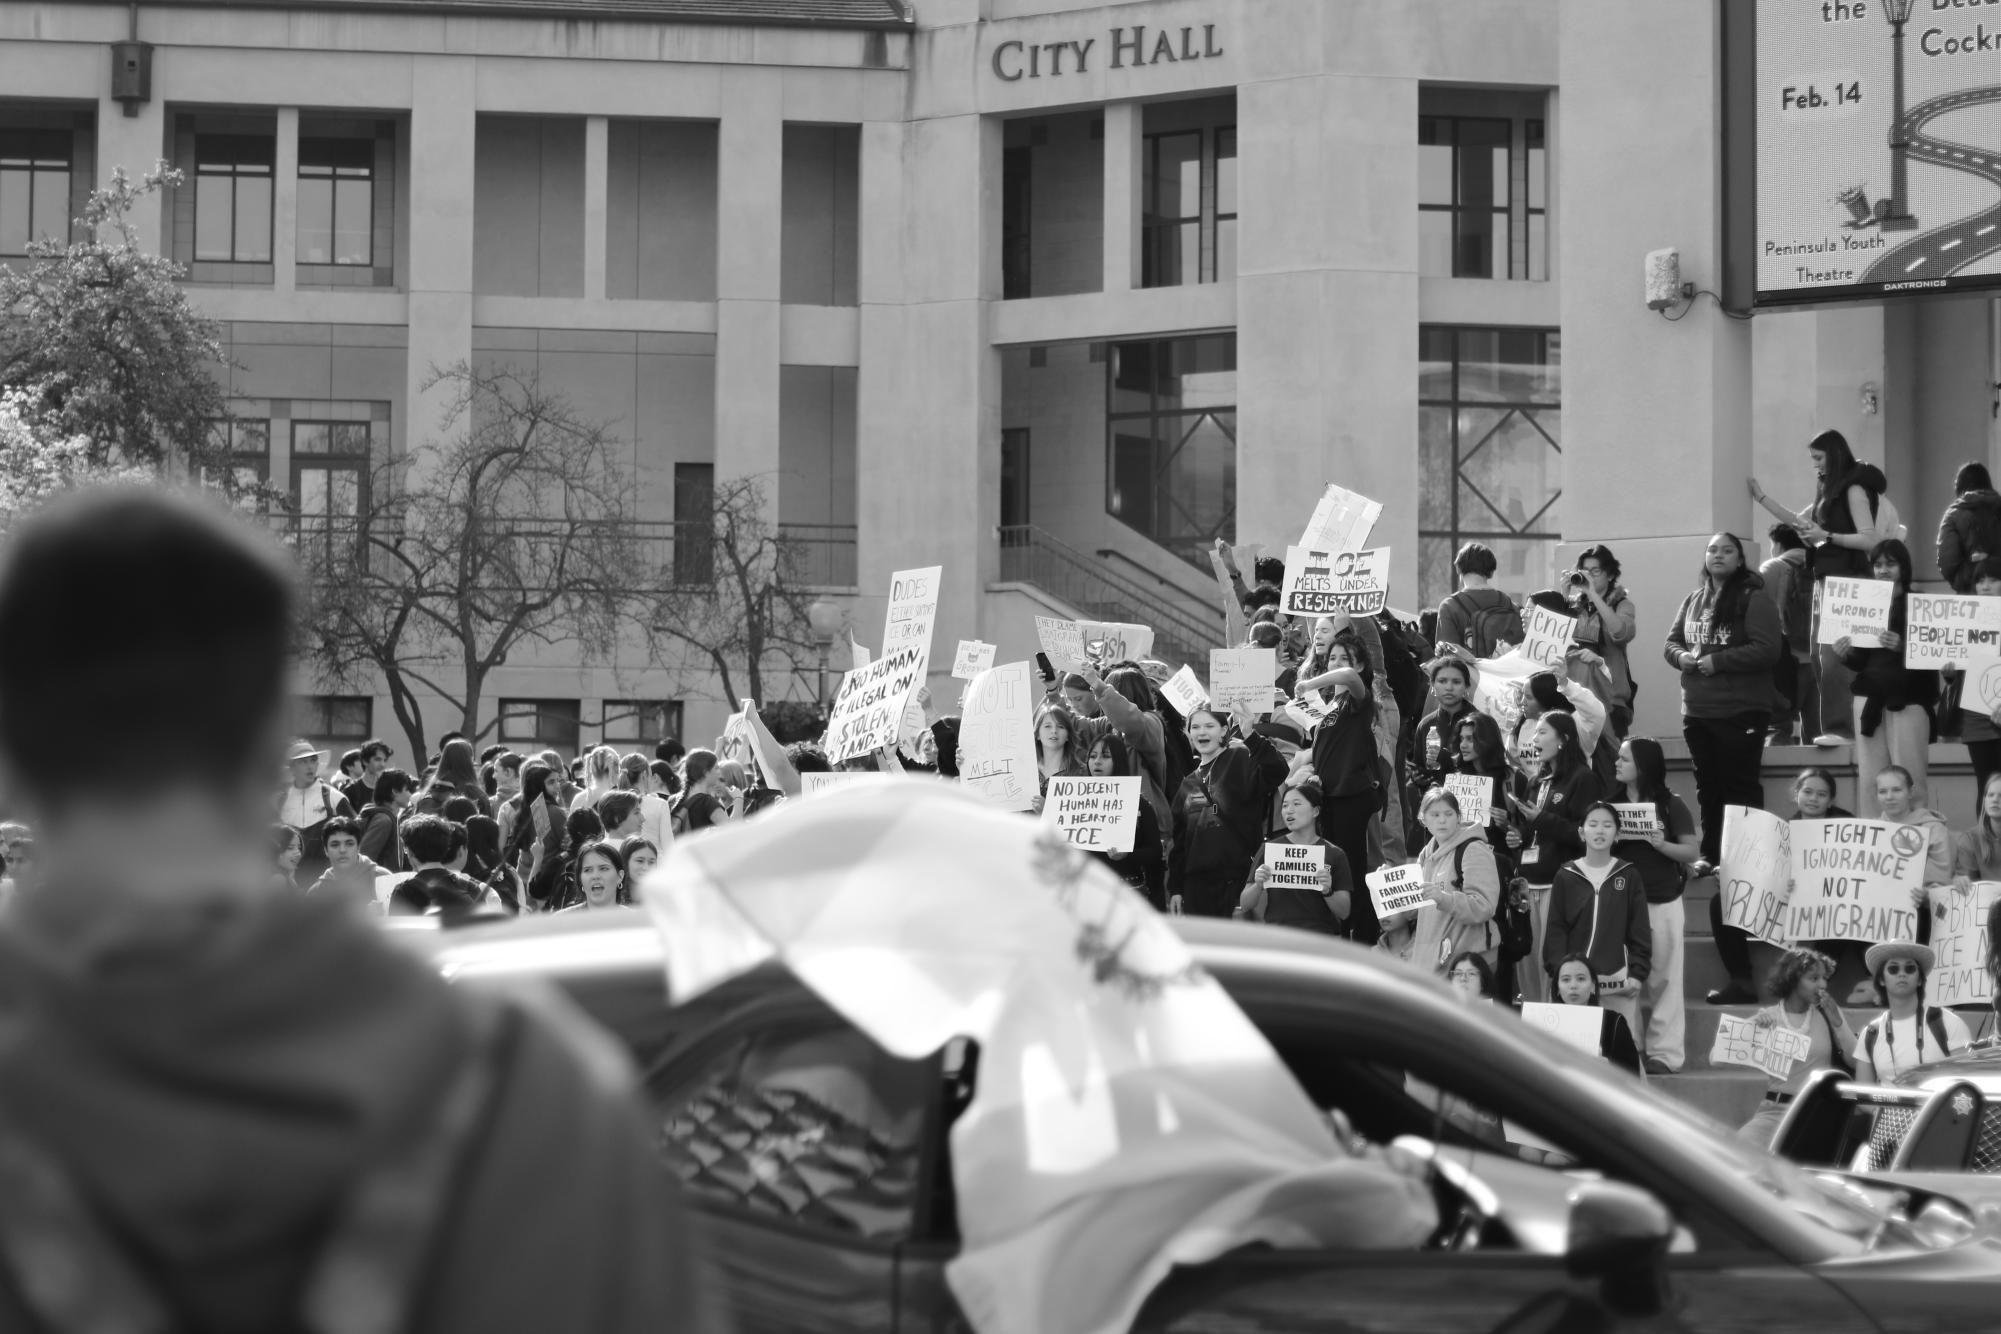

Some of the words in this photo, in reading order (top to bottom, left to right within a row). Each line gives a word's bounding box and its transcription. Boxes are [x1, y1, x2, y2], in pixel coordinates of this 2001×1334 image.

[1822, 0, 1867, 23] the
[1782, 85, 1828, 110] Feb.
[1836, 81, 1862, 105] 14
[1765, 237, 1837, 257] Peninsula
[1842, 231, 1886, 251] Youth
[1797, 266, 1853, 284] Theatre
[1884, 280, 1947, 291] DAKTRONICS
[1304, 551, 1374, 578] ICE
[1294, 577, 1331, 591] MELTS
[1339, 577, 1378, 591] UNDER
[1827, 581, 1859, 599] THE
[1293, 592, 1381, 611] RESISTANCE
[1911, 597, 1979, 622] PROTECT
[1832, 603, 1884, 620] WRONG!
[1908, 625, 1964, 645] PEOPLE
[1968, 629, 2000, 645] NOT
[1909, 643, 1968, 659] POWER
[870, 647, 920, 682] HUMAN
[847, 685, 887, 714] ILLEGAL
[892, 673, 913, 696] ON
[1054, 782, 1073, 796] NO
[1078, 782, 1120, 796] DECENT
[1059, 798, 1099, 811] HUMAN
[1103, 799, 1123, 811] HAS
[1057, 815, 1064, 825] A
[1071, 814, 1106, 825] HEART
[1108, 815, 1122, 825] OF
[1628, 811, 1647, 819] THEY
[1624, 821, 1638, 829] FOR
[1639, 821, 1653, 830] THE
[1823, 823, 1886, 846] FIGHT
[1063, 827, 1102, 845] ICE
[1284, 847, 1308, 859] KEEP
[1274, 861, 1317, 873] FAMILIES
[1803, 848, 1910, 880] IGNORANCE
[1384, 869, 1407, 882] KEEP
[1378, 881, 1420, 899] FAMILIES
[1823, 877, 1867, 900] NOT
[1790, 905, 1916, 942] IMMIGRANTS
[1933, 935, 1964, 969] ICE
[1721, 1019, 1763, 1044] ICE
[1765, 1027, 1810, 1059] NEEDS
